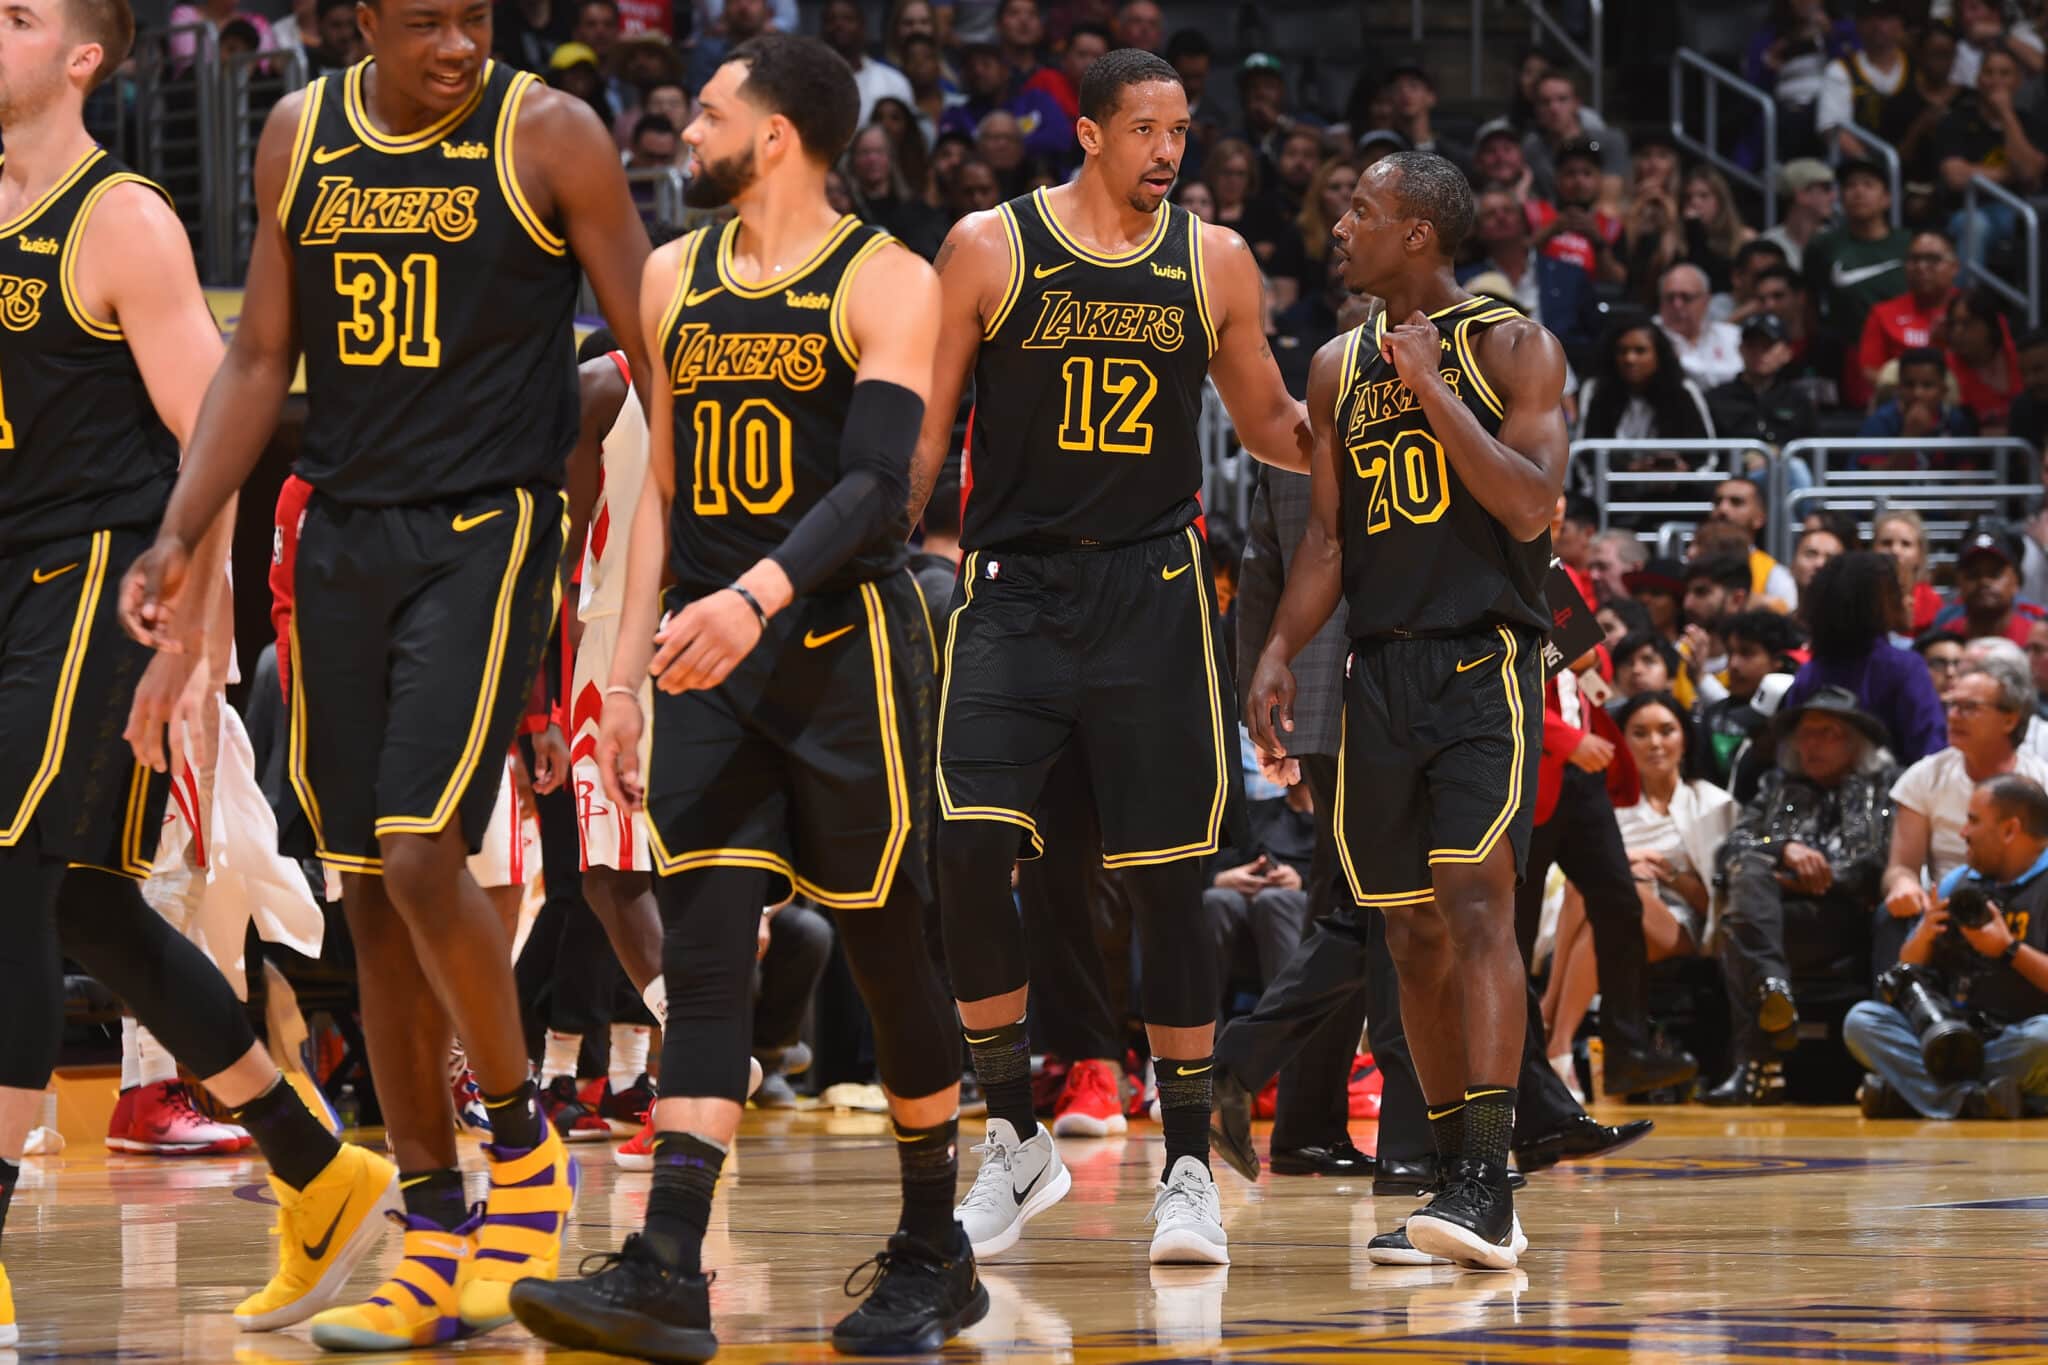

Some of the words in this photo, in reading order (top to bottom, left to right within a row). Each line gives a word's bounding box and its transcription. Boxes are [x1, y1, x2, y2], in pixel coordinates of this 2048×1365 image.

[441, 141, 489, 159] wish
[18, 234, 60, 256] wish
[300, 176, 479, 245] LAKERS
[785, 289, 829, 312] wish
[1150, 262, 1187, 282] wish
[334, 252, 441, 368] 31
[1021, 290, 1186, 353] LAKERS
[672, 323, 826, 395] LAKERS
[1058, 356, 1158, 455] 12
[693, 398, 794, 516] 10
[1349, 429, 1450, 535] 20
